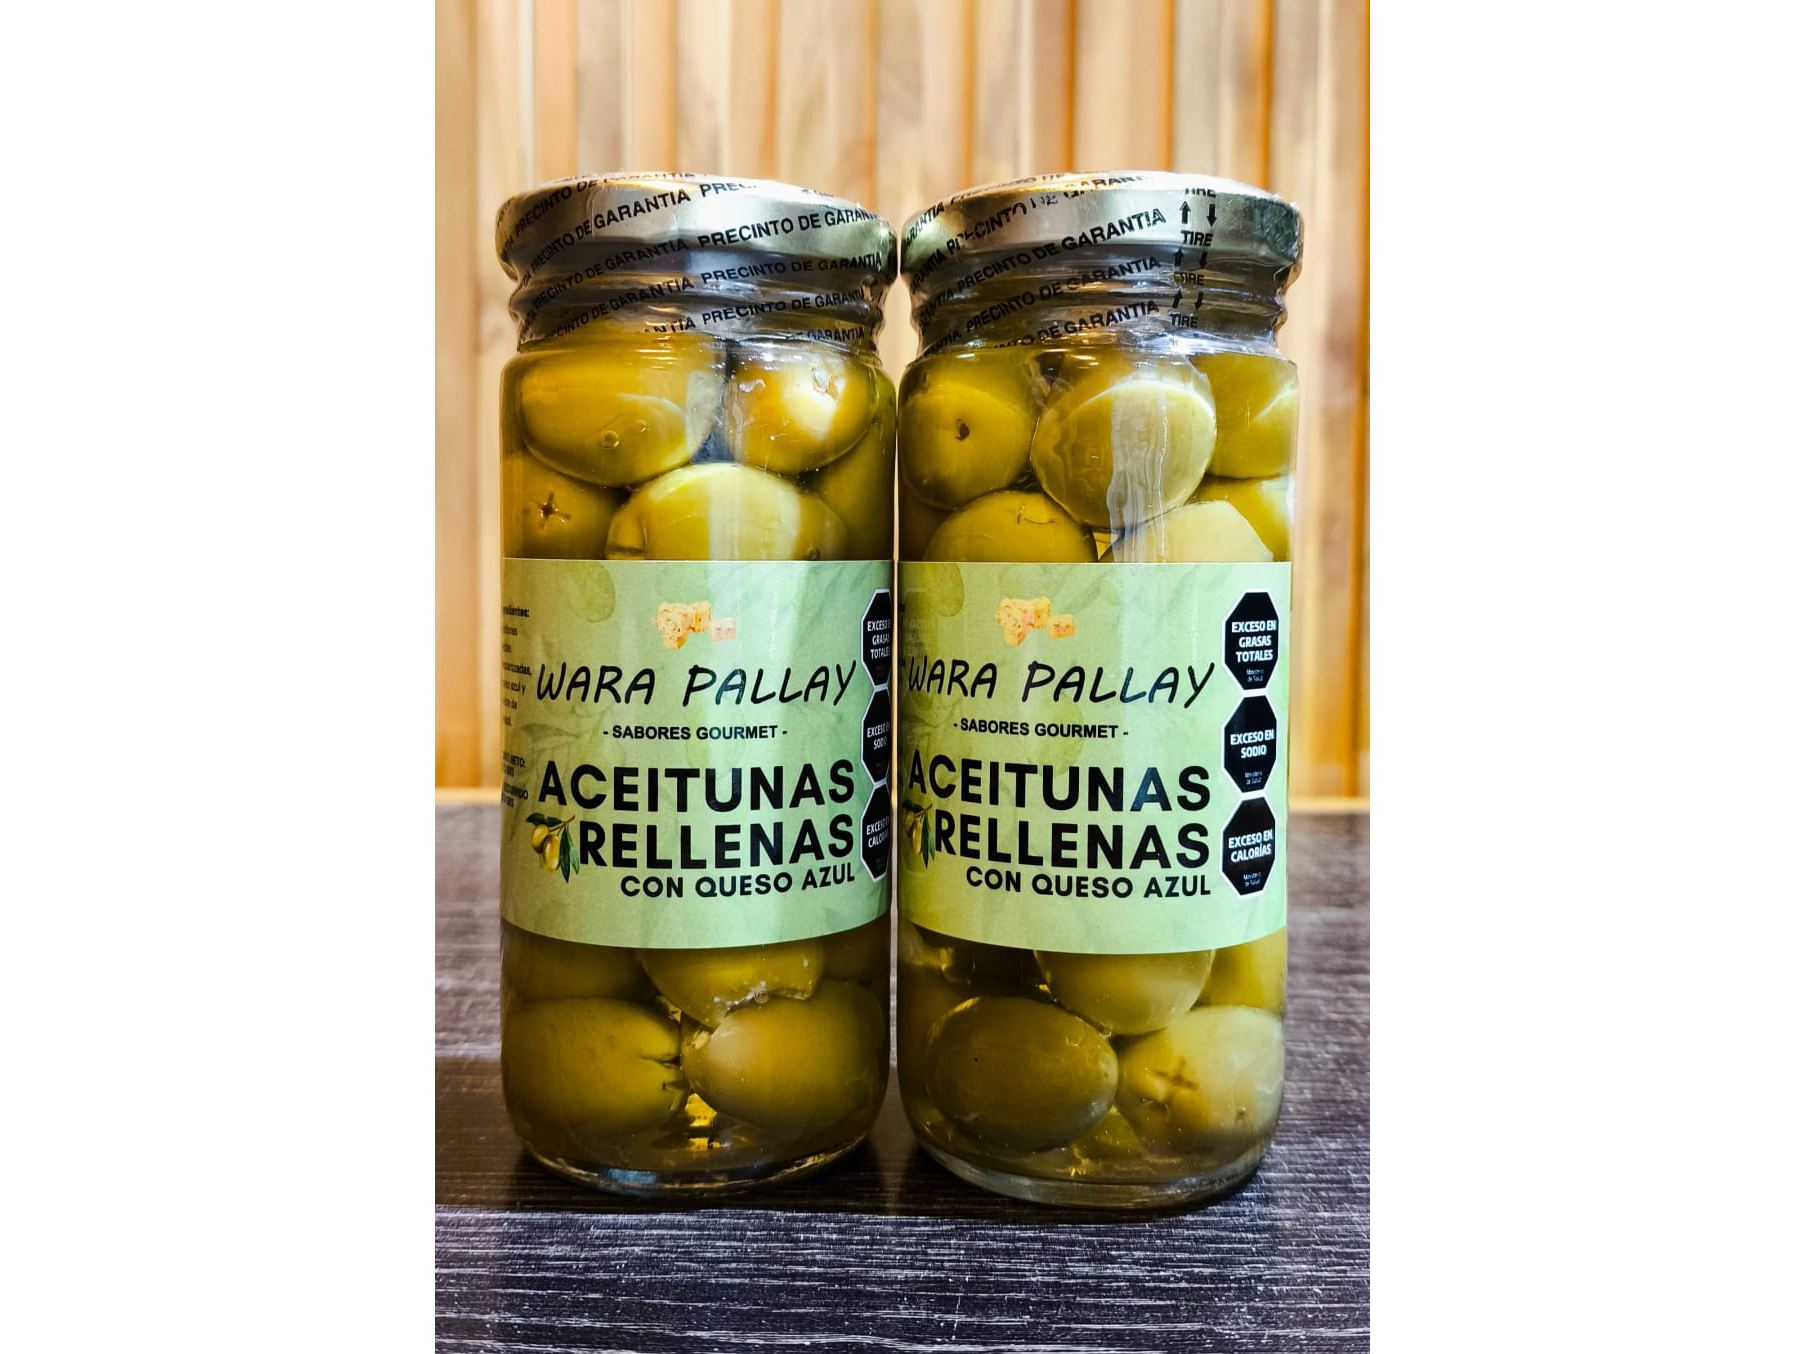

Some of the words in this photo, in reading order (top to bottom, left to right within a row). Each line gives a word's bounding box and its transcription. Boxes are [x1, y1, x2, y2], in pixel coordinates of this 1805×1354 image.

[515, 186, 571, 237] PRECINTO
[531, 233, 575, 273] PRECINTO
[576, 220, 592, 240] DE
[593, 188, 691, 230] GARANTIA
[1181, 230, 1214, 247] TIRE
[535, 272, 584, 306] PRECINTO
[585, 263, 604, 278] DE
[605, 238, 690, 271] GARANTIA
[698, 217, 794, 249] PRECINTO
[799, 212, 821, 231] DE
[957, 253, 1031, 293] PRECINTO
[1033, 243, 1060, 260] DE
[1061, 208, 1166, 250] GARANTIA
[592, 306, 609, 321] DE
[610, 275, 695, 310] GARANTIA
[701, 261, 786, 284] PRECINTO
[792, 260, 813, 272] DE
[823, 252, 882, 271] GARANTIA
[966, 291, 1036, 333] PRECINTO
[1039, 281, 1064, 301] DE
[1067, 256, 1161, 291] GARANTIA
[702, 301, 787, 325] PRECINTO
[792, 297, 812, 309] DE
[1038, 324, 1062, 342] DE
[1064, 300, 1159, 335] GARANTIA
[1170, 313, 1199, 328] TIRE
[1231, 620, 1266, 633] EXCESO
[1266, 619, 1277, 631] EN
[1238, 635, 1272, 648] GRASAS
[1235, 649, 1273, 663] TOTALES
[537, 661, 656, 704] WARA
[682, 660, 857, 707] PALLAY
[908, 654, 998, 699] WARA
[1021, 660, 1215, 709] PALLAY
[612, 725, 691, 740] SABORES
[696, 725, 778, 740] GOURMET
[960, 717, 1030, 736] SABORES
[1034, 722, 1119, 739] GOURMET
[1230, 731, 1264, 745] EXCESO
[1264, 729, 1275, 741] EN
[1240, 744, 1267, 759] SODIO
[538, 759, 855, 812] ACEITUNAS
[908, 750, 1211, 812] ACEITUNAS
[579, 814, 855, 870] RELLENAS
[935, 808, 1210, 870] RELLENAS
[1228, 832, 1262, 849] EXCESO
[1263, 829, 1273, 842] EN
[1230, 843, 1272, 863] CALORÍAS
[620, 875, 684, 898] CON
[695, 872, 793, 898] QUESO
[801, 862, 855, 891] AZUL
[966, 866, 1021, 892] CON
[1031, 873, 1134, 899] QUESO
[1143, 875, 1211, 898] AZUL
